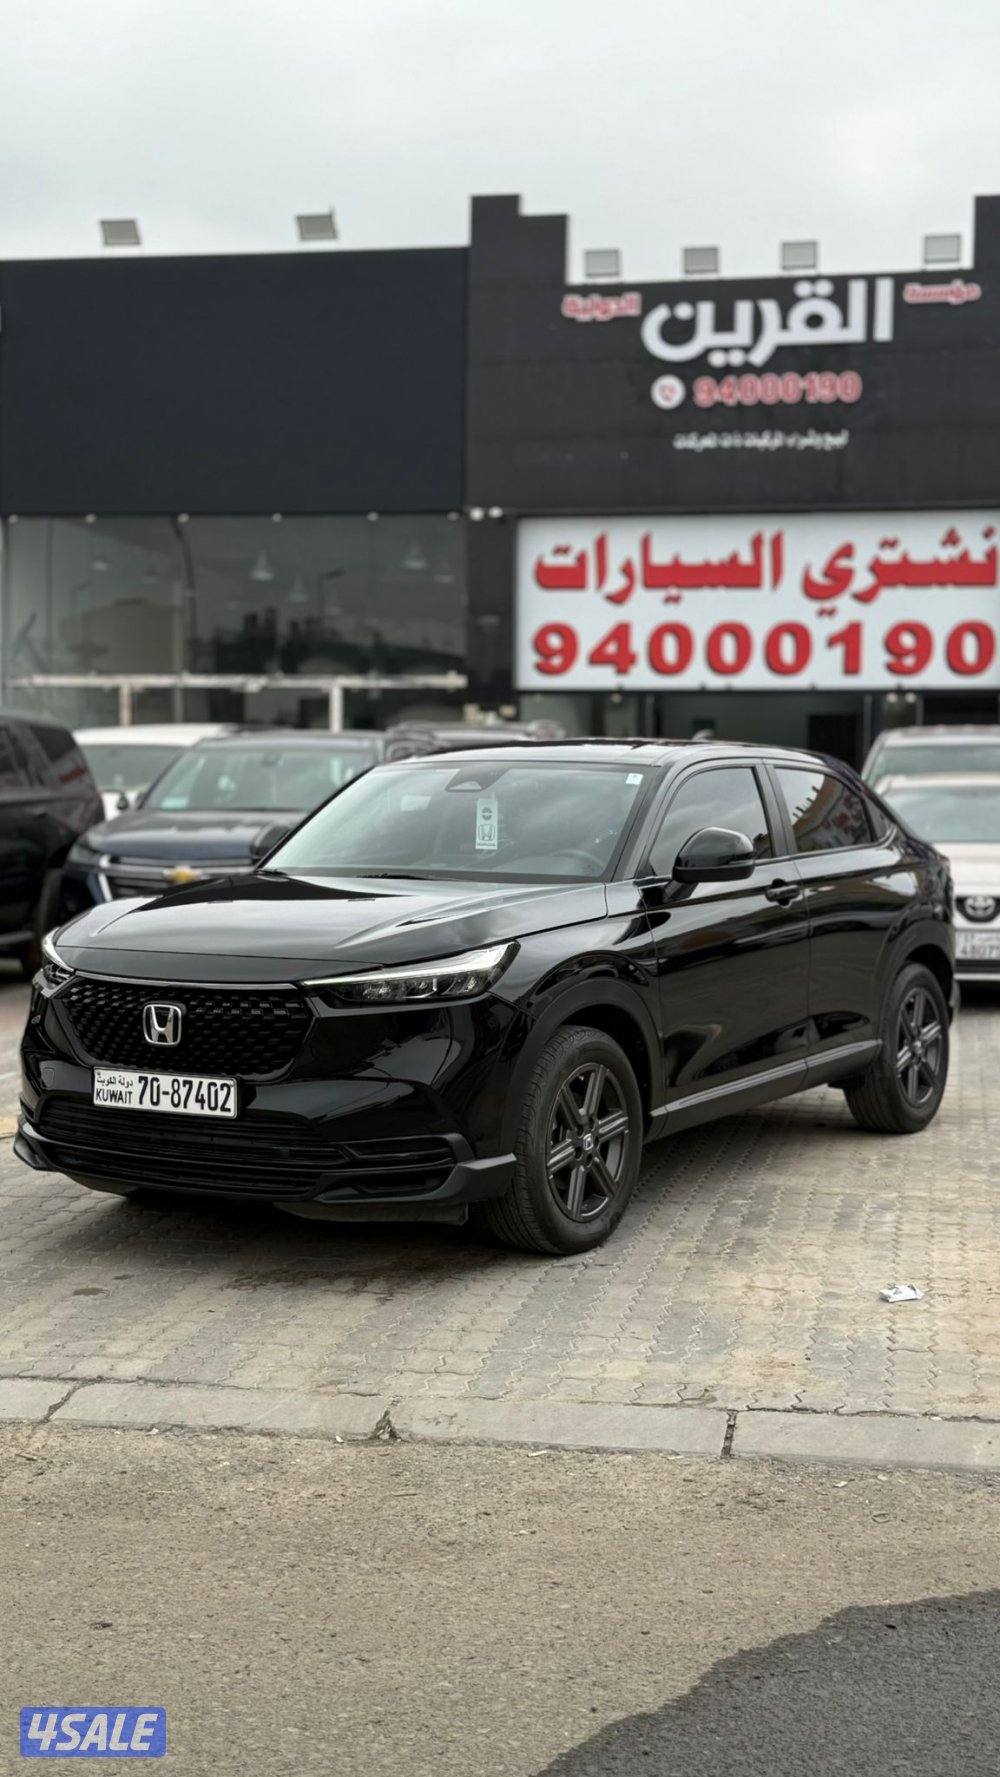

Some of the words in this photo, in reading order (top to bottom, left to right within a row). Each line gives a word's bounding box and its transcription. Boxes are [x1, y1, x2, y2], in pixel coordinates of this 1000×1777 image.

[903, 279, 981, 305] مؤسسة
[640, 276, 895, 368] القرين
[692, 371, 862, 408] 94000190
[534, 528, 783, 606] السيارات
[803, 525, 998, 617] نشتري
[533, 622, 996, 677] 94000190
[95, 1088, 133, 1105] KUWAIT
[96, 1072, 117, 1087] الكويت
[117, 1074, 134, 1089] دولة
[138, 1075, 232, 1112] 70-87402
